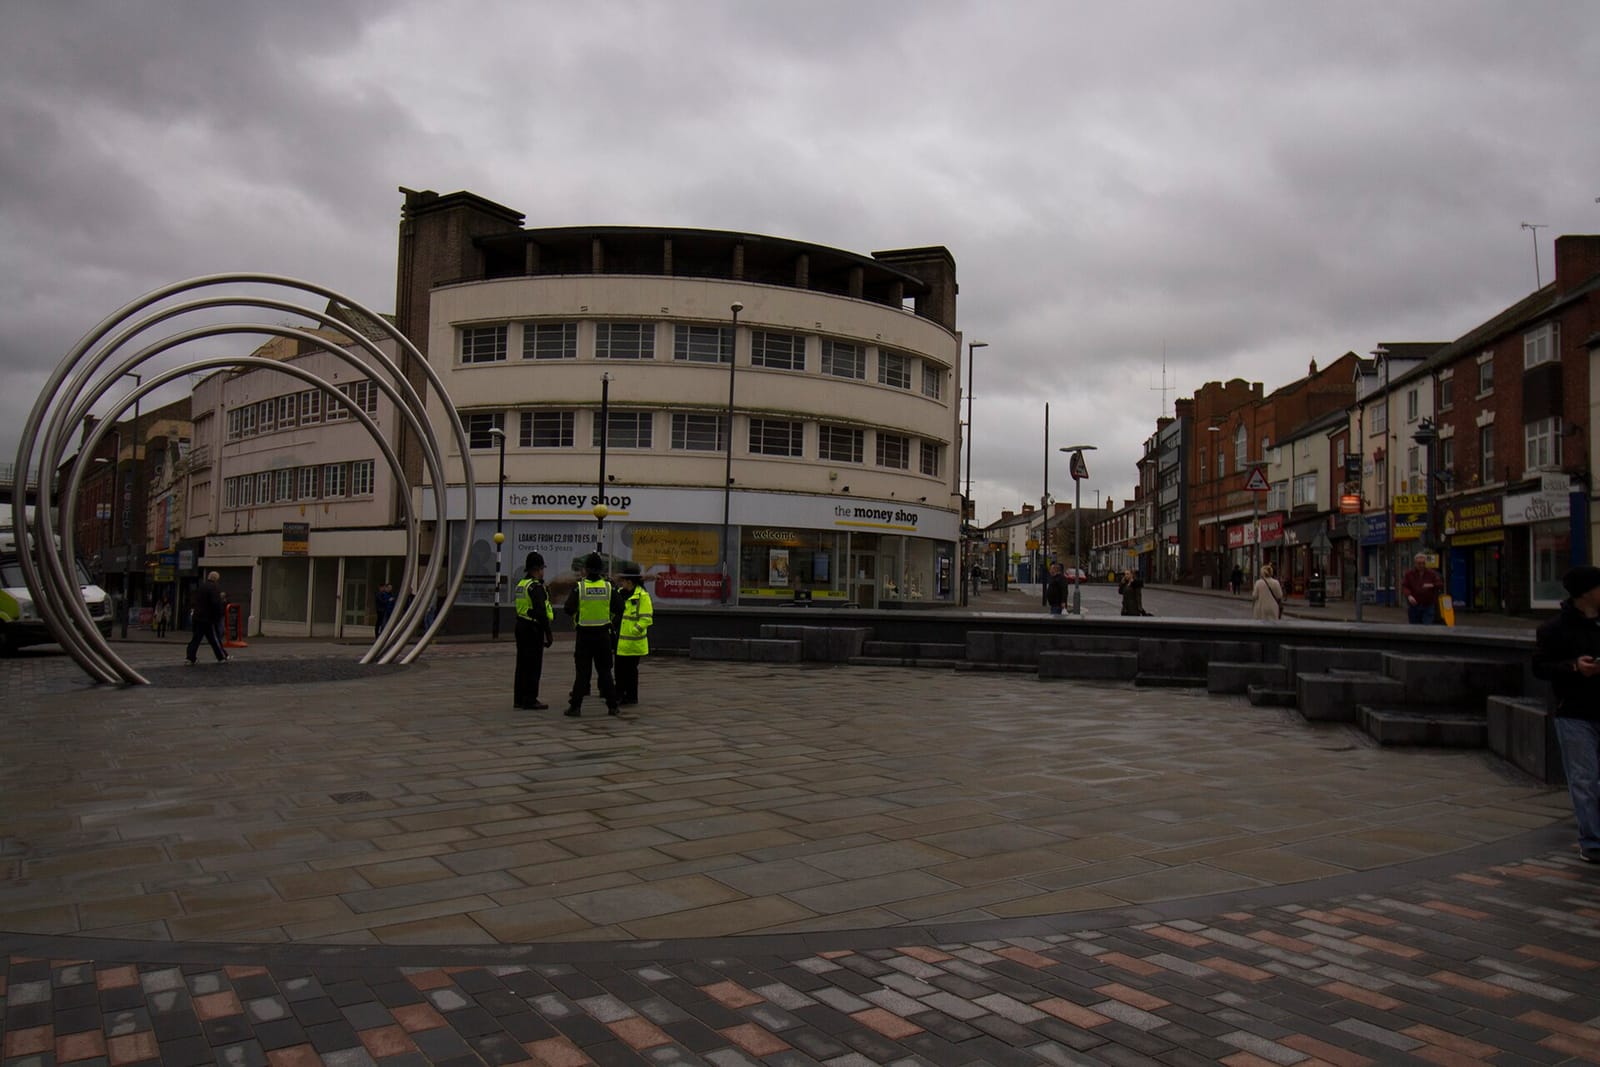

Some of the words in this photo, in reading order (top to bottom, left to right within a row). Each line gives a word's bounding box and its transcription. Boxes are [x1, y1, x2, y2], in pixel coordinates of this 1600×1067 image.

[509, 494, 528, 505] the
[532, 494, 587, 509] money
[591, 495, 631, 509] shop
[1395, 495, 1409, 504] TO
[834, 506, 851, 517] the
[854, 506, 893, 523] money
[895, 509, 918, 525] shop
[518, 534, 537, 543] LOANS
[538, 534, 554, 543] FROM
[575, 535, 582, 543] TO
[752, 528, 798, 541] welcome
[664, 579, 701, 588] personal
